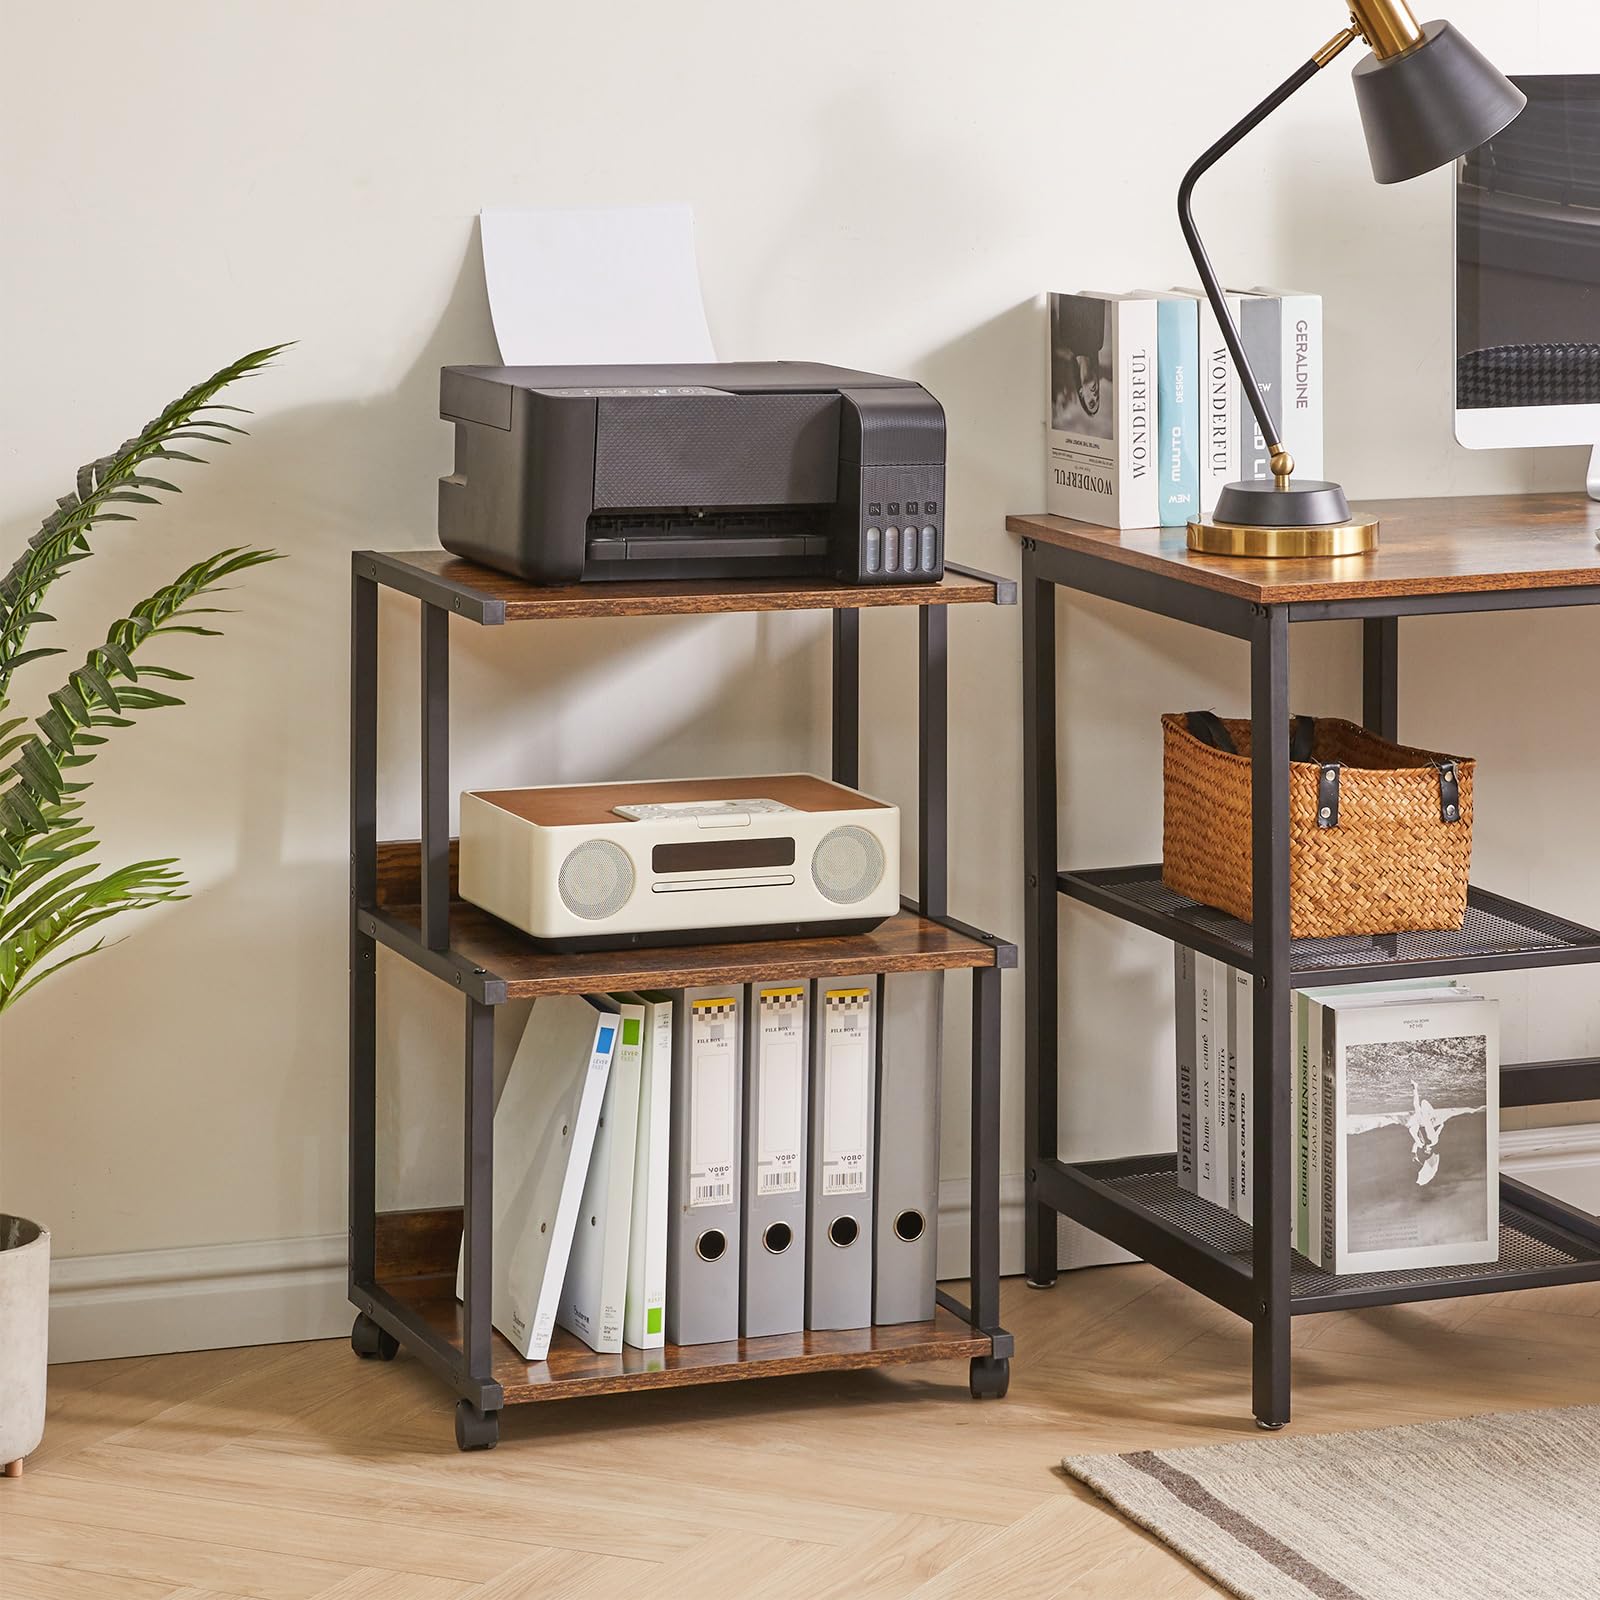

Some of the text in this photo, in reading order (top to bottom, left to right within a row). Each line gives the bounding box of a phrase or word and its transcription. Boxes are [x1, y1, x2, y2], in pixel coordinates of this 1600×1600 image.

[1175, 365, 1184, 403] DESIGN
[1295, 320, 1308, 409] GERALDINE
[1132, 348, 1146, 479] WONDERFUL
[1212, 347, 1227, 477] WONDERFUL
[1054, 467, 1113, 496] WONDERFUL
[1169, 493, 1191, 504] NEW
[890, 504, 897, 513] Y
[908, 504, 916, 513] M
[1201, 1080, 1210, 1108] aux
[1323, 1076, 1333, 1137] HOMELIFE
[1180, 1063, 1194, 1174] SPECIAL ISSUE
[1201, 1117, 1211, 1153] Dame
[1300, 1045, 1309, 1208] CHERISH FRIENDSHIP
[1201, 1161, 1211, 1181] La
[1240, 1148, 1247, 1158] &
[1323, 1138, 1333, 1214] WONDERFUL
[1323, 1215, 1334, 1260] CREATE
